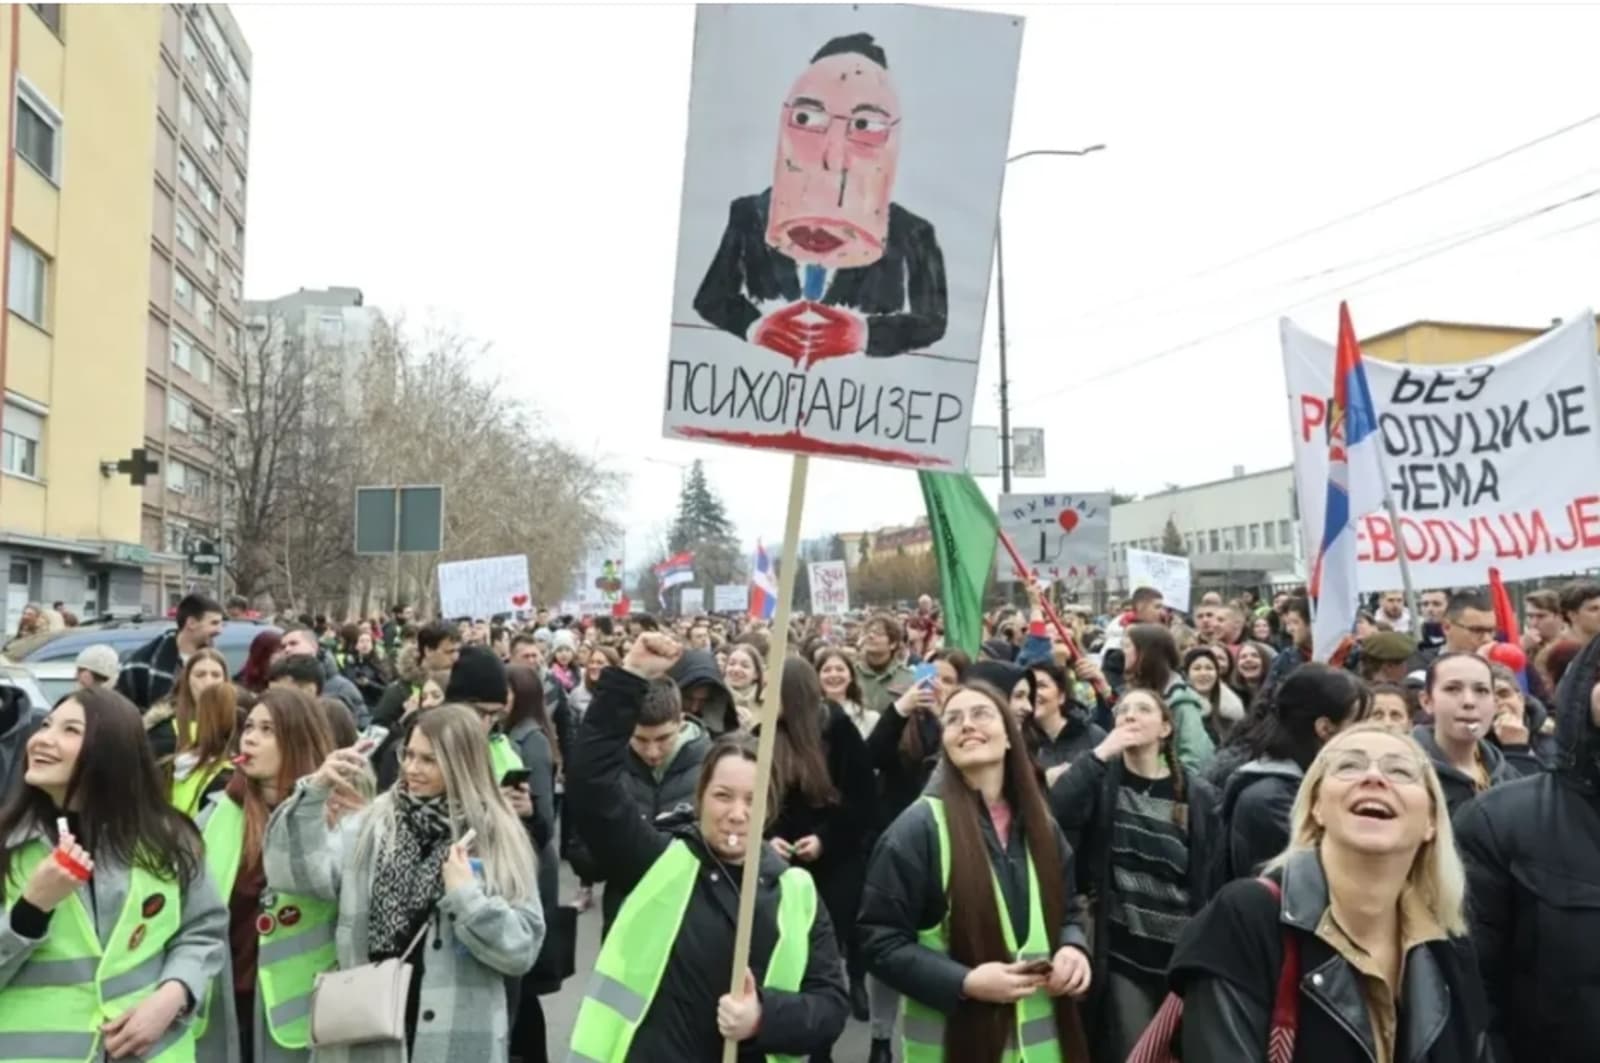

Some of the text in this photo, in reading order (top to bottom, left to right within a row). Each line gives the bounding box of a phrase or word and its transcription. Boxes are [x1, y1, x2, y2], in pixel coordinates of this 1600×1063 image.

[666, 360, 962, 443] ПСИХОПАРИЗЕР
[1301, 386, 1590, 457] РОЛУЦИЈЕ
[1013, 495, 1097, 520] ПУМПАЈ
